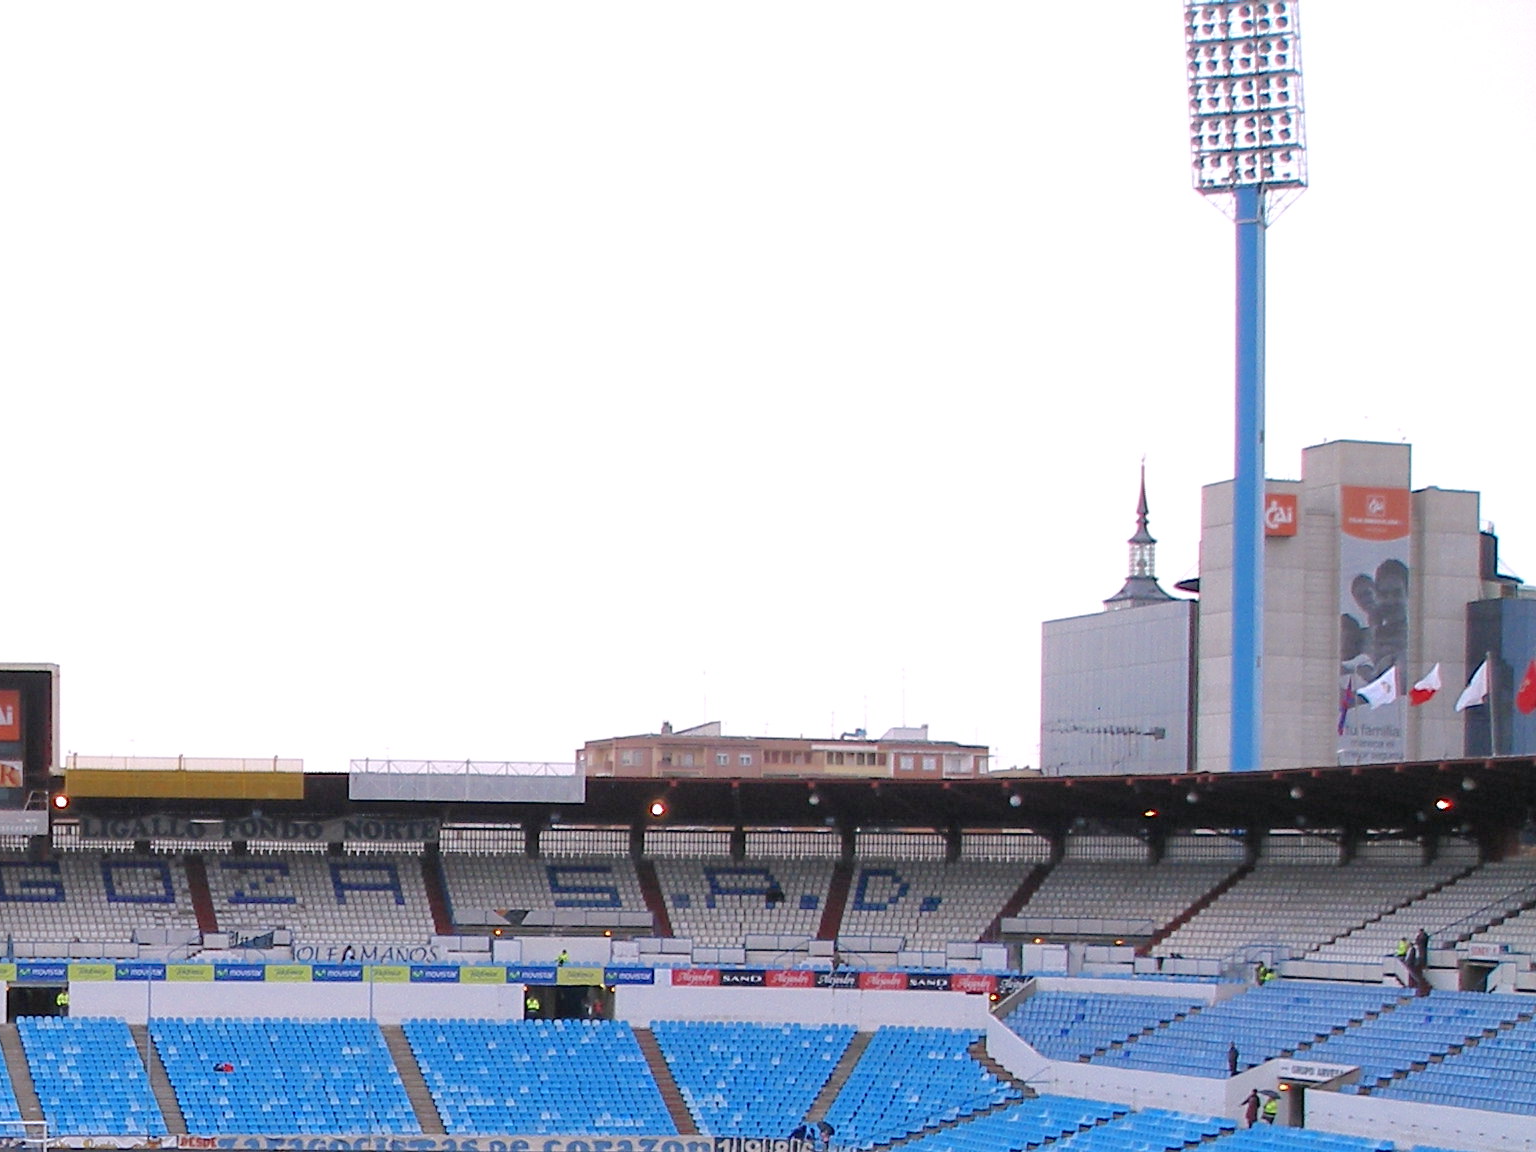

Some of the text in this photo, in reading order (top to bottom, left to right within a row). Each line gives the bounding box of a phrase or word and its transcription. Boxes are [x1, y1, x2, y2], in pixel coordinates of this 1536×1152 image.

[83, 817, 439, 841] LIGALLO FONDO NORTE
[722, 975, 763, 983] SAND
[909, 978, 948, 987] SAND
